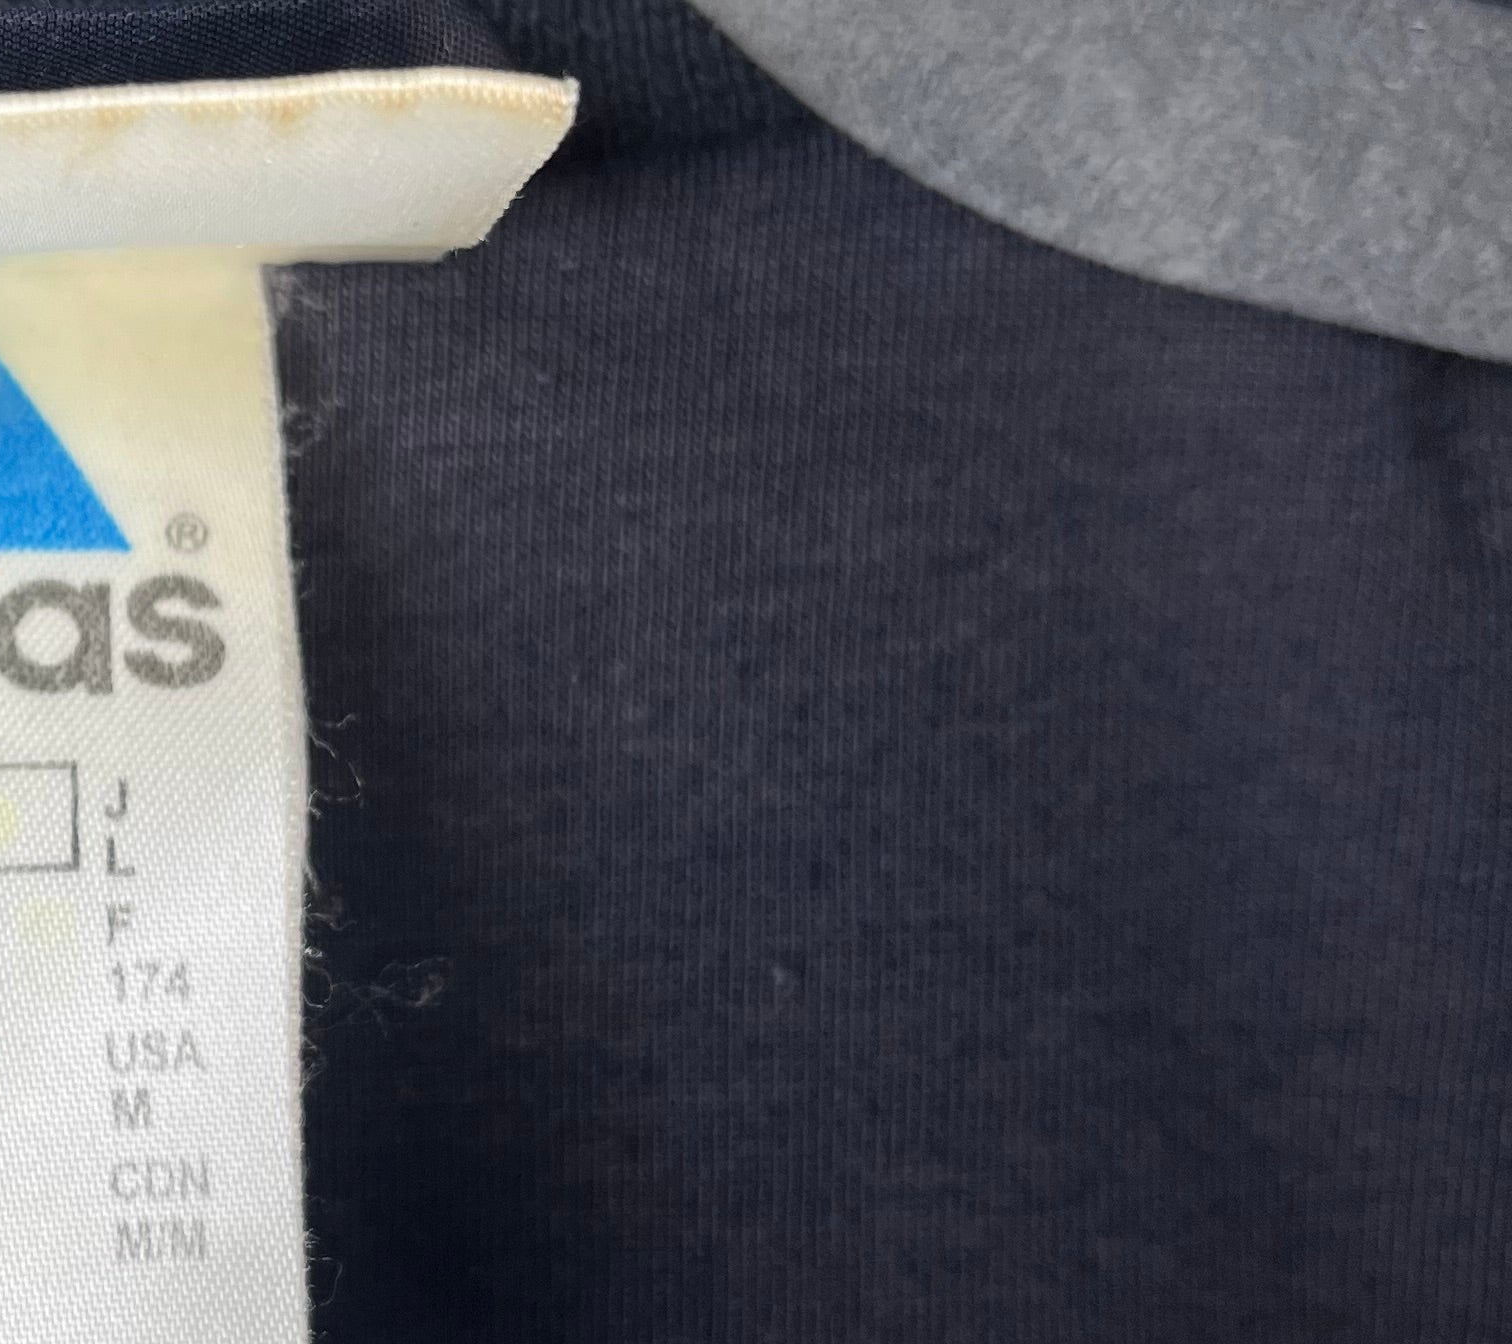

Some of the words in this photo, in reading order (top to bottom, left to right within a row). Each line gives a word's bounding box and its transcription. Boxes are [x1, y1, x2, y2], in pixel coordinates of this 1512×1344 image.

[104, 777, 129, 821] J
[106, 834, 136, 877] L
[105, 902, 134, 947] F
[108, 959, 193, 1004] 174
[104, 1029, 208, 1075] USA
[110, 1087, 153, 1131] M
[108, 1156, 212, 1202] CDN
[114, 1213, 208, 1261] M/M
